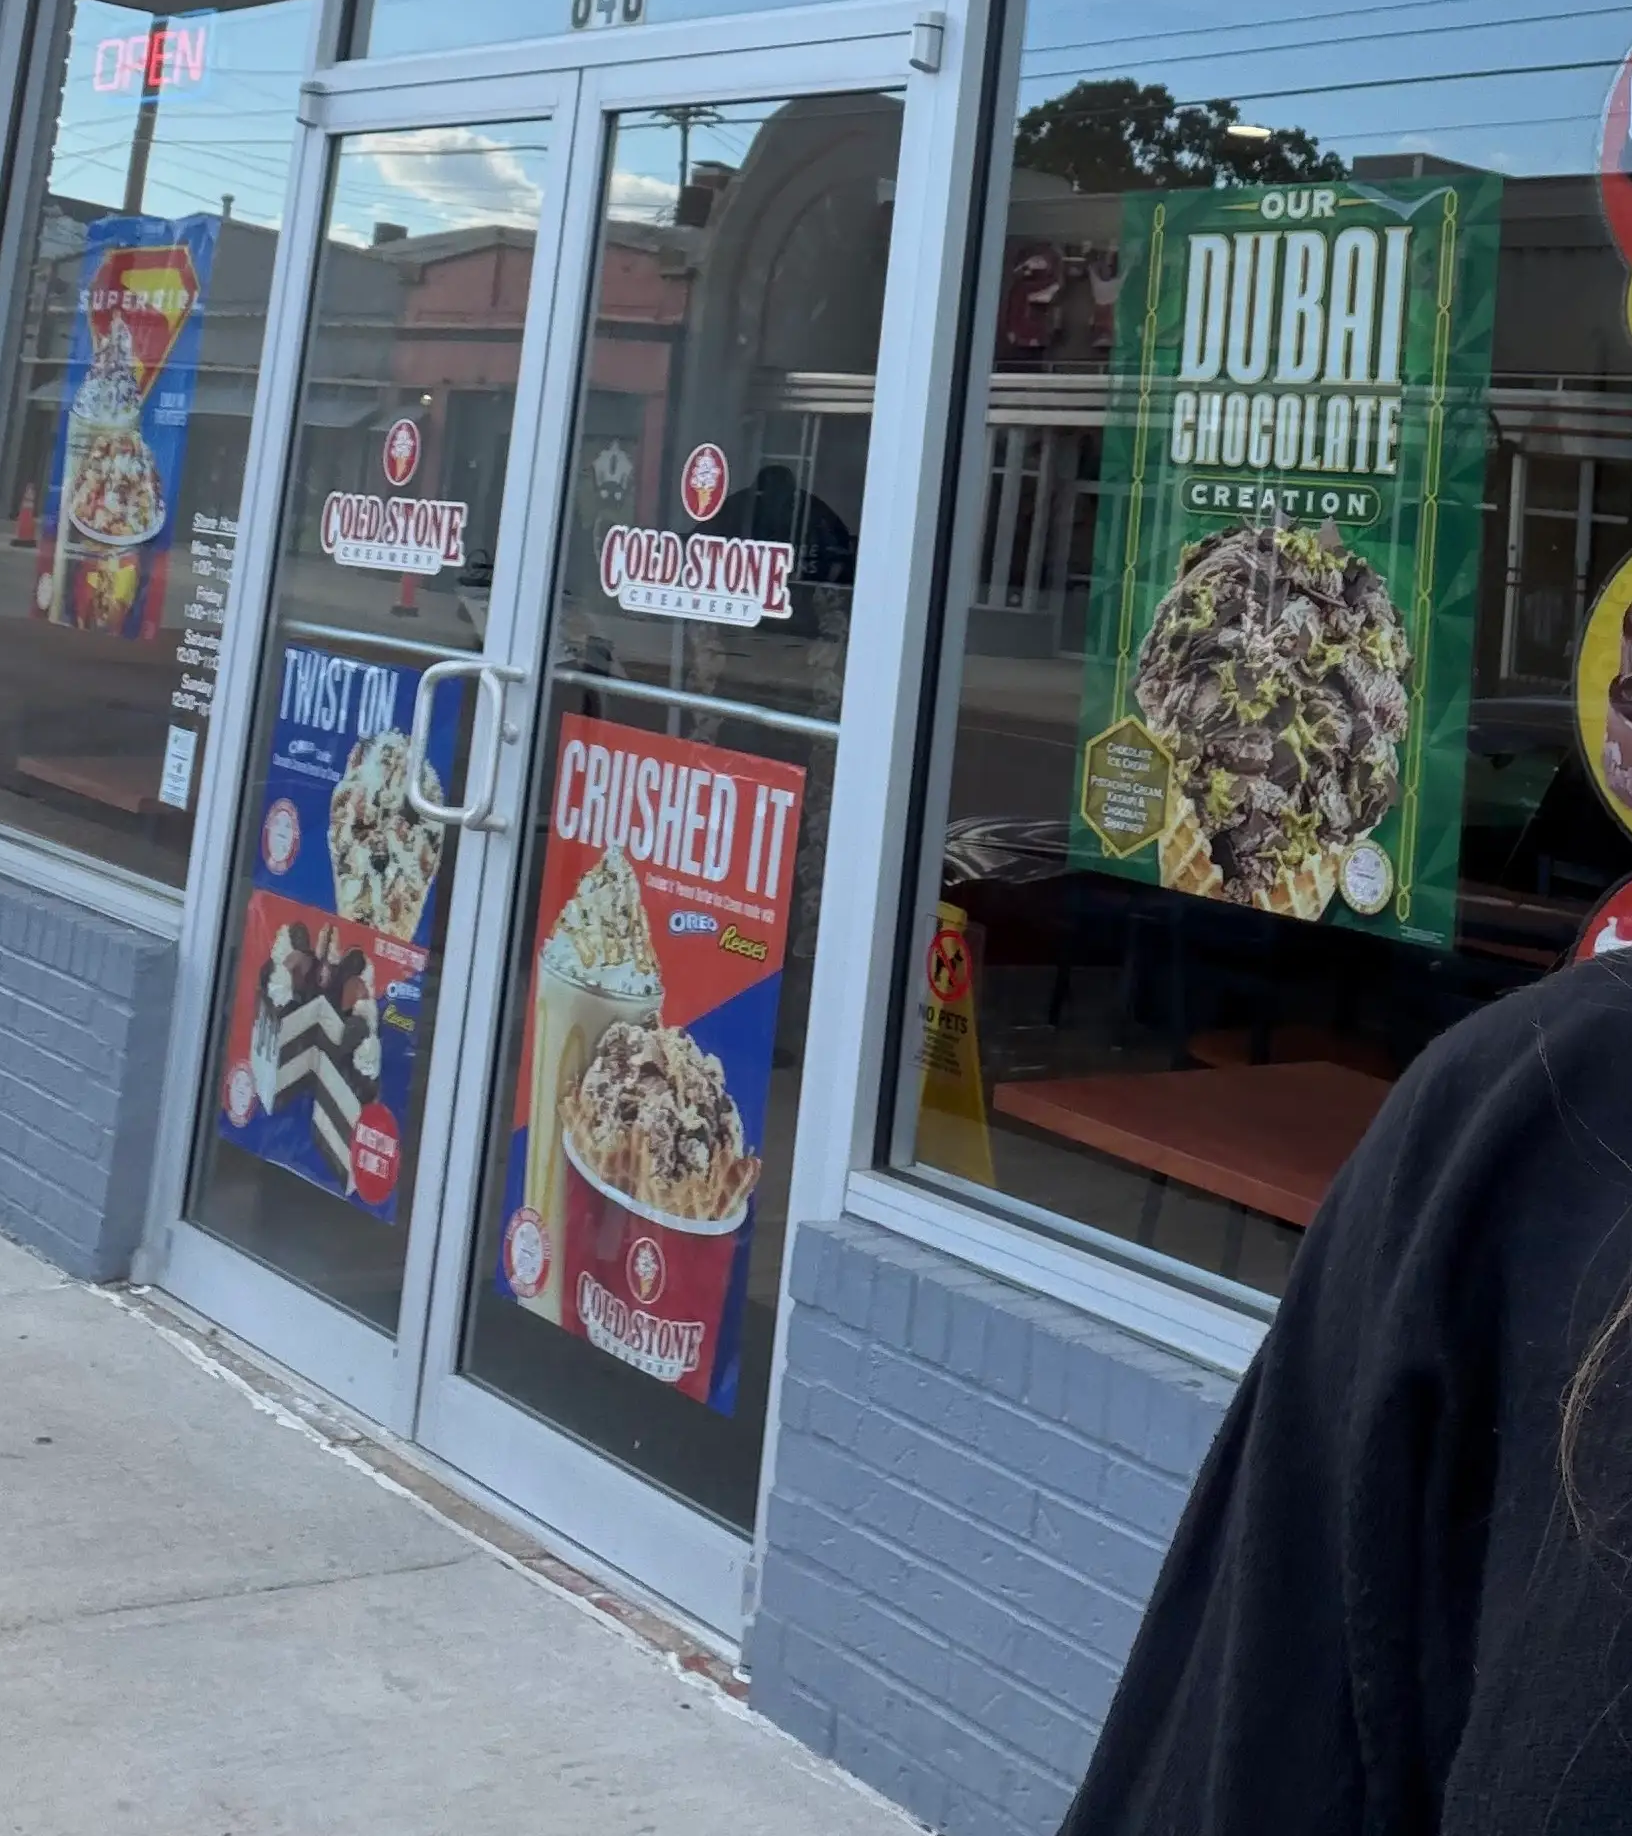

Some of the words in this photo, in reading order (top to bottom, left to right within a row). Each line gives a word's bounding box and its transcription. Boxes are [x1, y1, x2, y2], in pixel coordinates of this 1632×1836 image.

[93, 27, 206, 91] OPEN
[1261, 189, 1337, 219] OUR
[79, 289, 205, 313] SUPERGIRL
[1177, 226, 1413, 386] DUBAI
[1171, 391, 1403, 476] CHOCOLATE
[323, 495, 381, 551] COLD
[381, 500, 465, 561] STONE
[1191, 483, 1369, 516] CREATION
[604, 530, 679, 594] COLD
[681, 536, 790, 614] STONE
[628, 588, 751, 617] CREAMERY
[279, 648, 357, 734] TWIST
[358, 666, 400, 740] ON
[556, 740, 737, 883] CRUSHED
[745, 784, 796, 900] IT
[669, 911, 717, 934] OREO
[917, 1003, 936, 1024] NO
[937, 1008, 969, 1035] PETS
[579, 1274, 629, 1343] COLD
[629, 1313, 703, 1369] STONE
